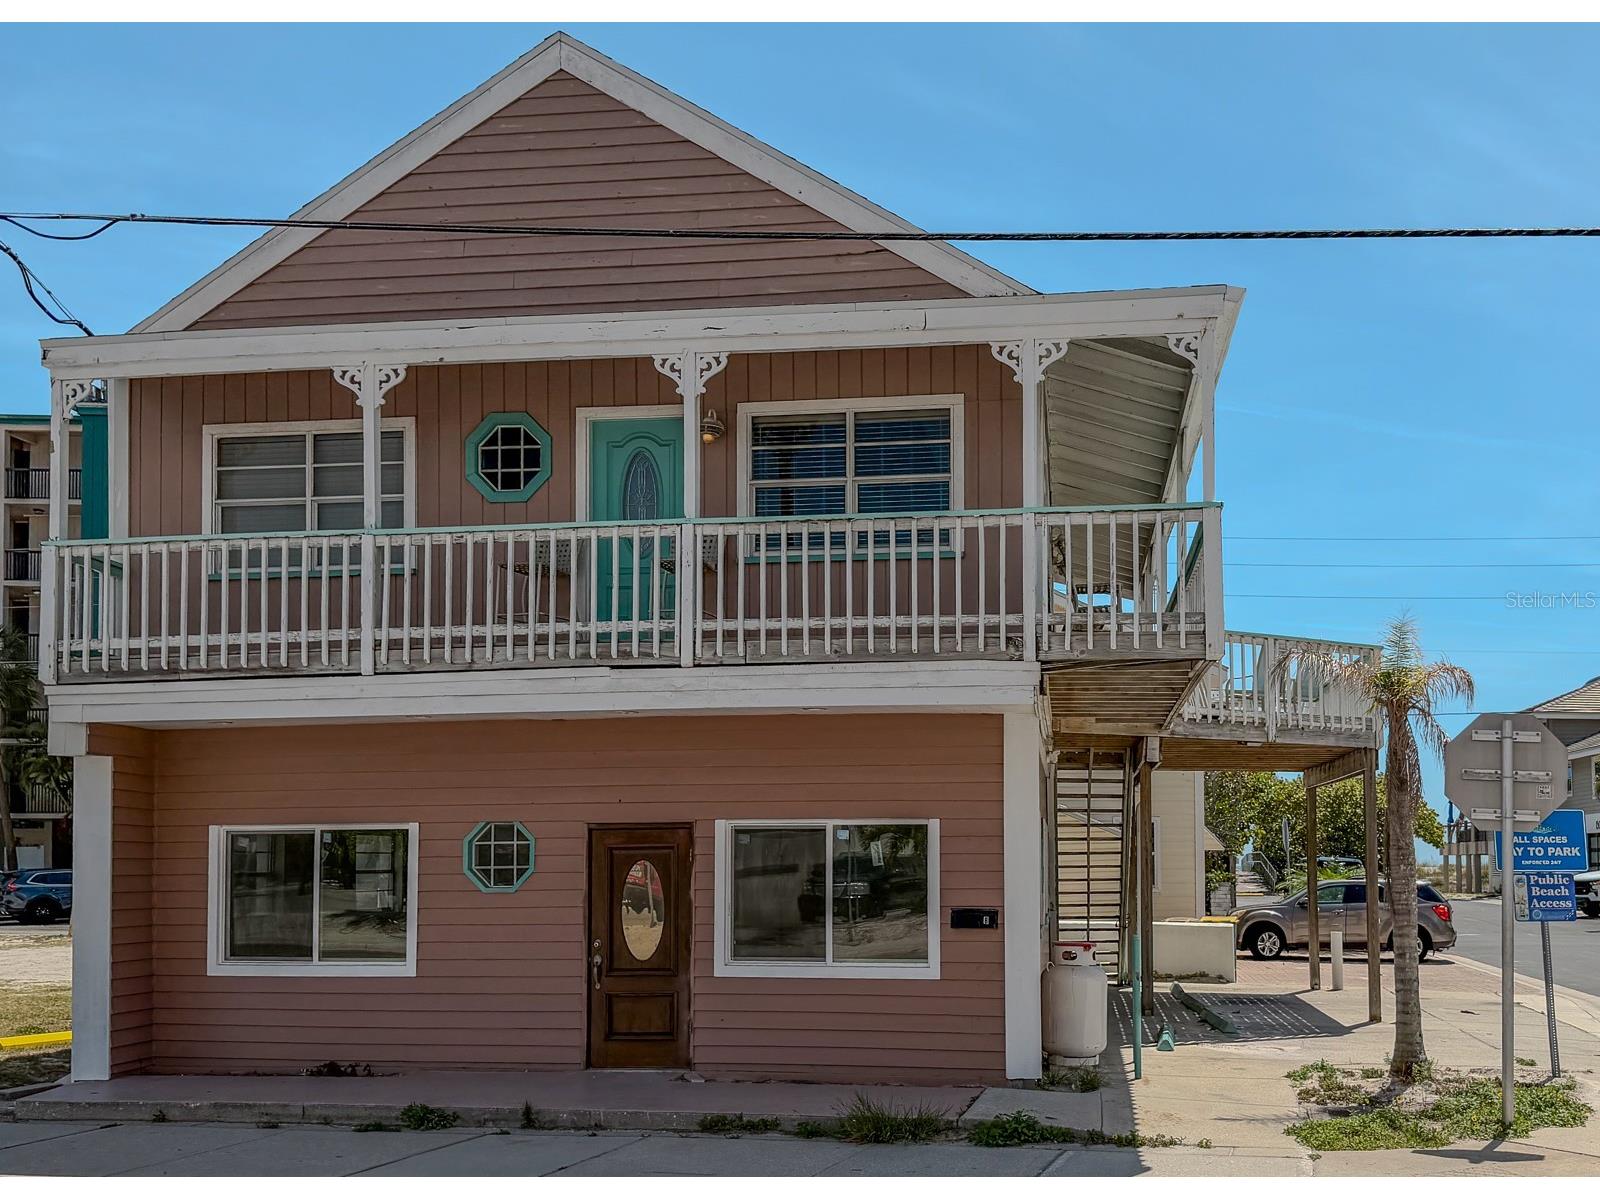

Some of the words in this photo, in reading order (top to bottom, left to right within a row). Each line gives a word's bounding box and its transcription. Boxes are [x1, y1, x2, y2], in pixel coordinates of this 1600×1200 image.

[1513, 836, 1530, 844] ALL
[1532, 836, 1568, 844] SPACES
[1527, 847, 1545, 857] TO
[1547, 847, 1581, 857] PARK
[1529, 874, 1570, 885] Public
[1530, 886, 1570, 896] Beach
[1530, 898, 1572, 908] Access
